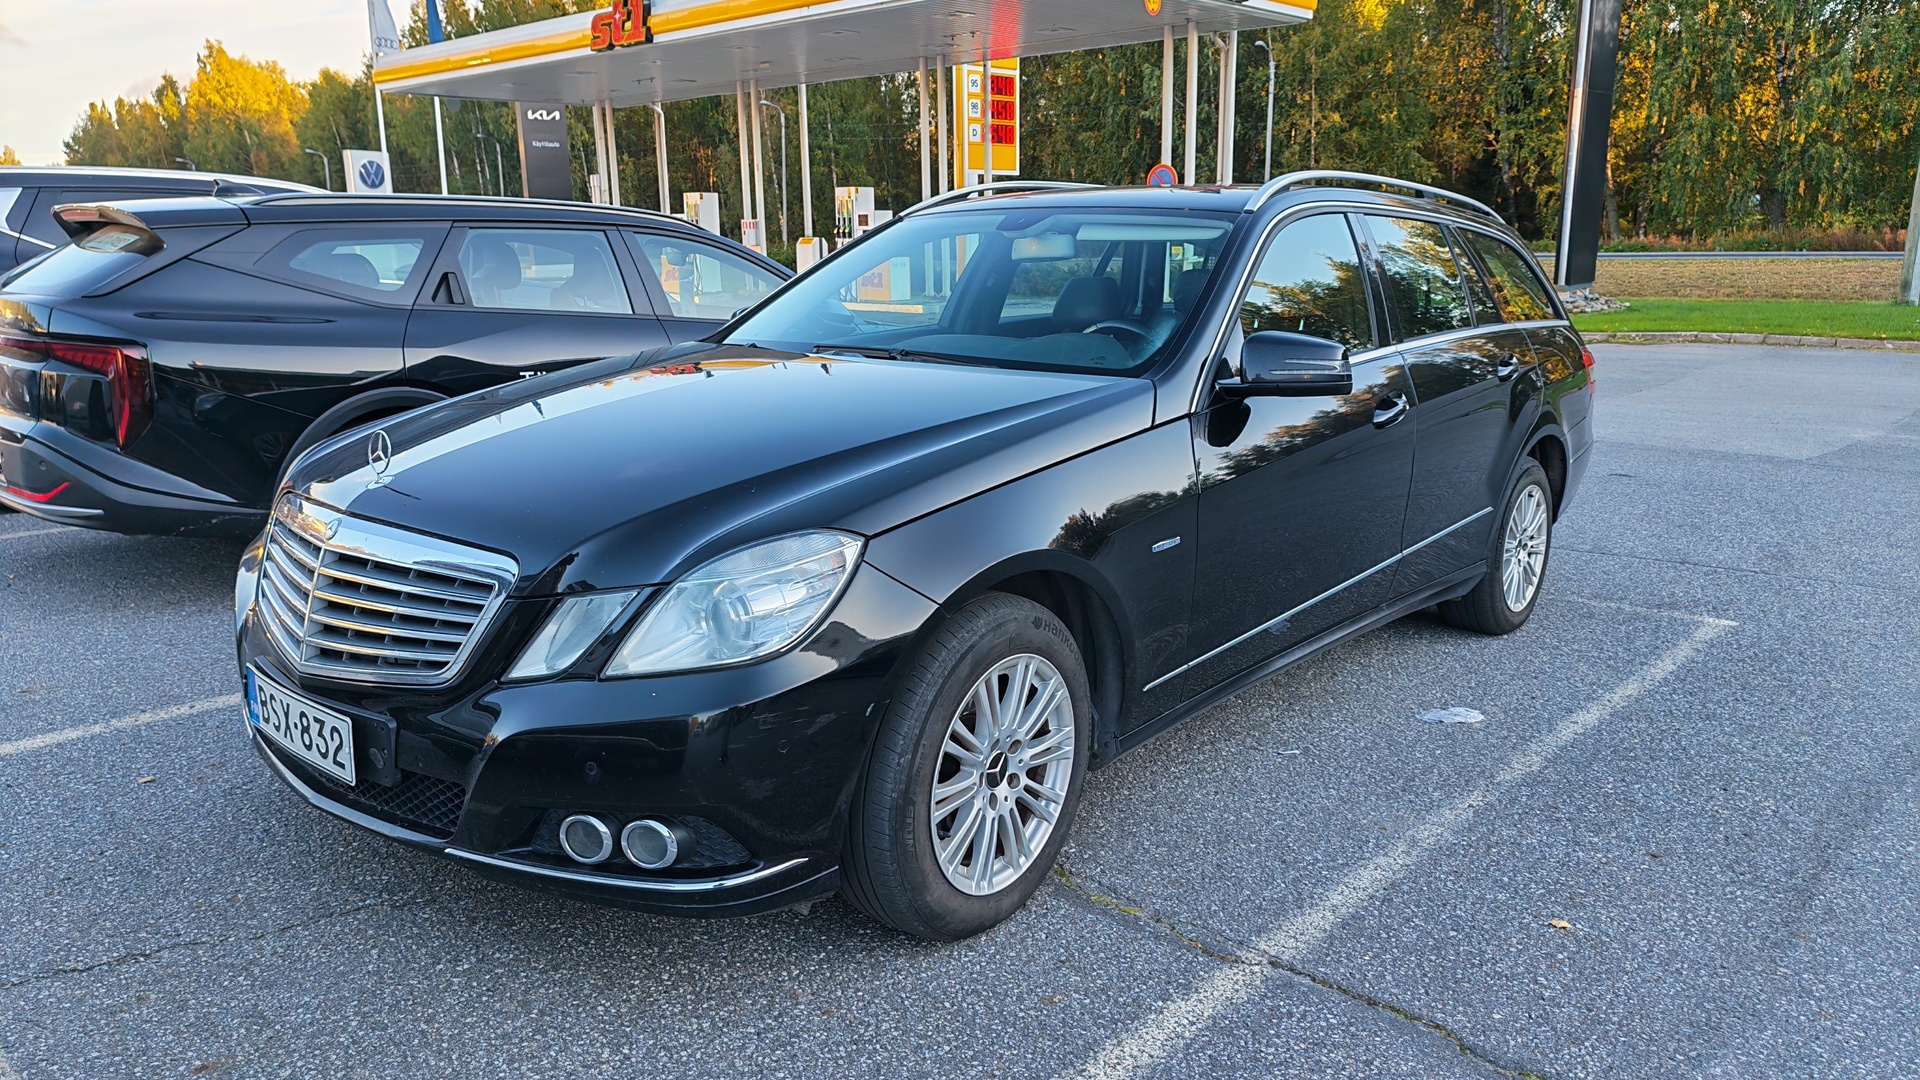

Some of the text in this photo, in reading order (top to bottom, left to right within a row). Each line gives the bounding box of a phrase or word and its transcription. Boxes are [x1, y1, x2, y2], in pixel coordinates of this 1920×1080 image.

[970, 78, 979, 88] 95
[970, 102, 979, 111] 98
[972, 128, 978, 137] D
[257, 684, 346, 770] BSX-832
